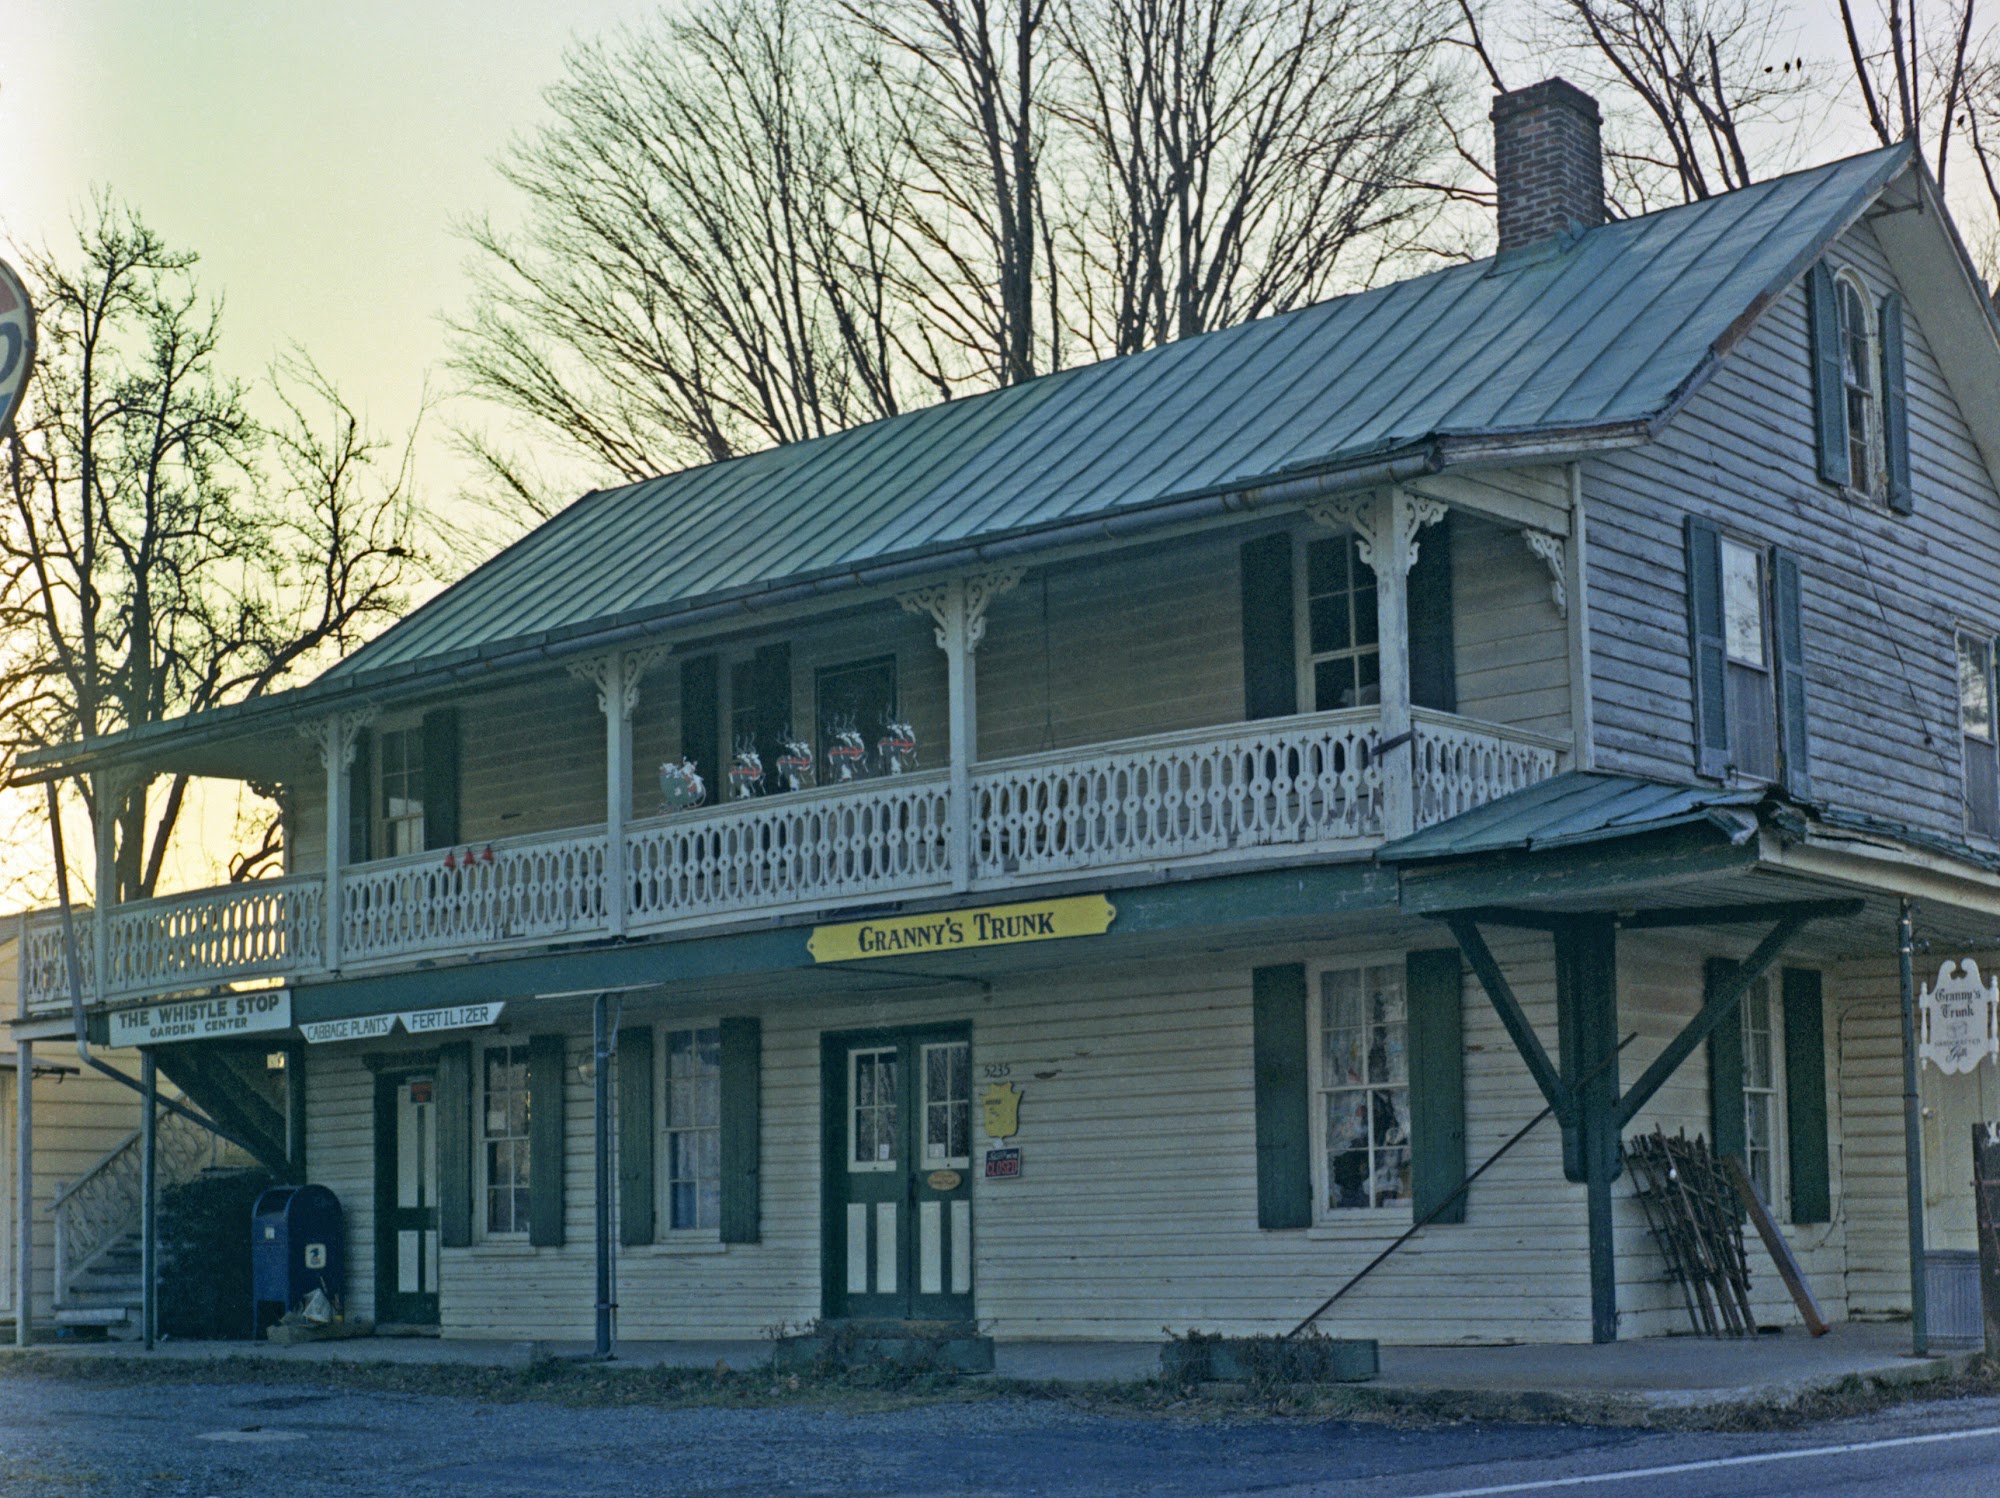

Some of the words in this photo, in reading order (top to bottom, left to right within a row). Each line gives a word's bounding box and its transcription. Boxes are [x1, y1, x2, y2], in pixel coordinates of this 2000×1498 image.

[858, 917, 964, 953] GRANNY'S
[973, 912, 1055, 941] TRUNK
[1935, 988, 1981, 1004] Granny's
[119, 1010, 150, 1028] THE
[158, 1001, 228, 1024] WHISTLE
[236, 994, 279, 1015] STOP
[412, 1006, 489, 1030] FERTILIZER
[1941, 1004, 1974, 1018] Trunk
[150, 1023, 195, 1039] GARDEN
[204, 1017, 248, 1032] CENTER
[307, 1021, 348, 1041] CABBAGE
[351, 1016, 389, 1035] PLANTS
[985, 1063, 1010, 1078] 5235
[987, 1159, 1018, 1175] CLOSED
